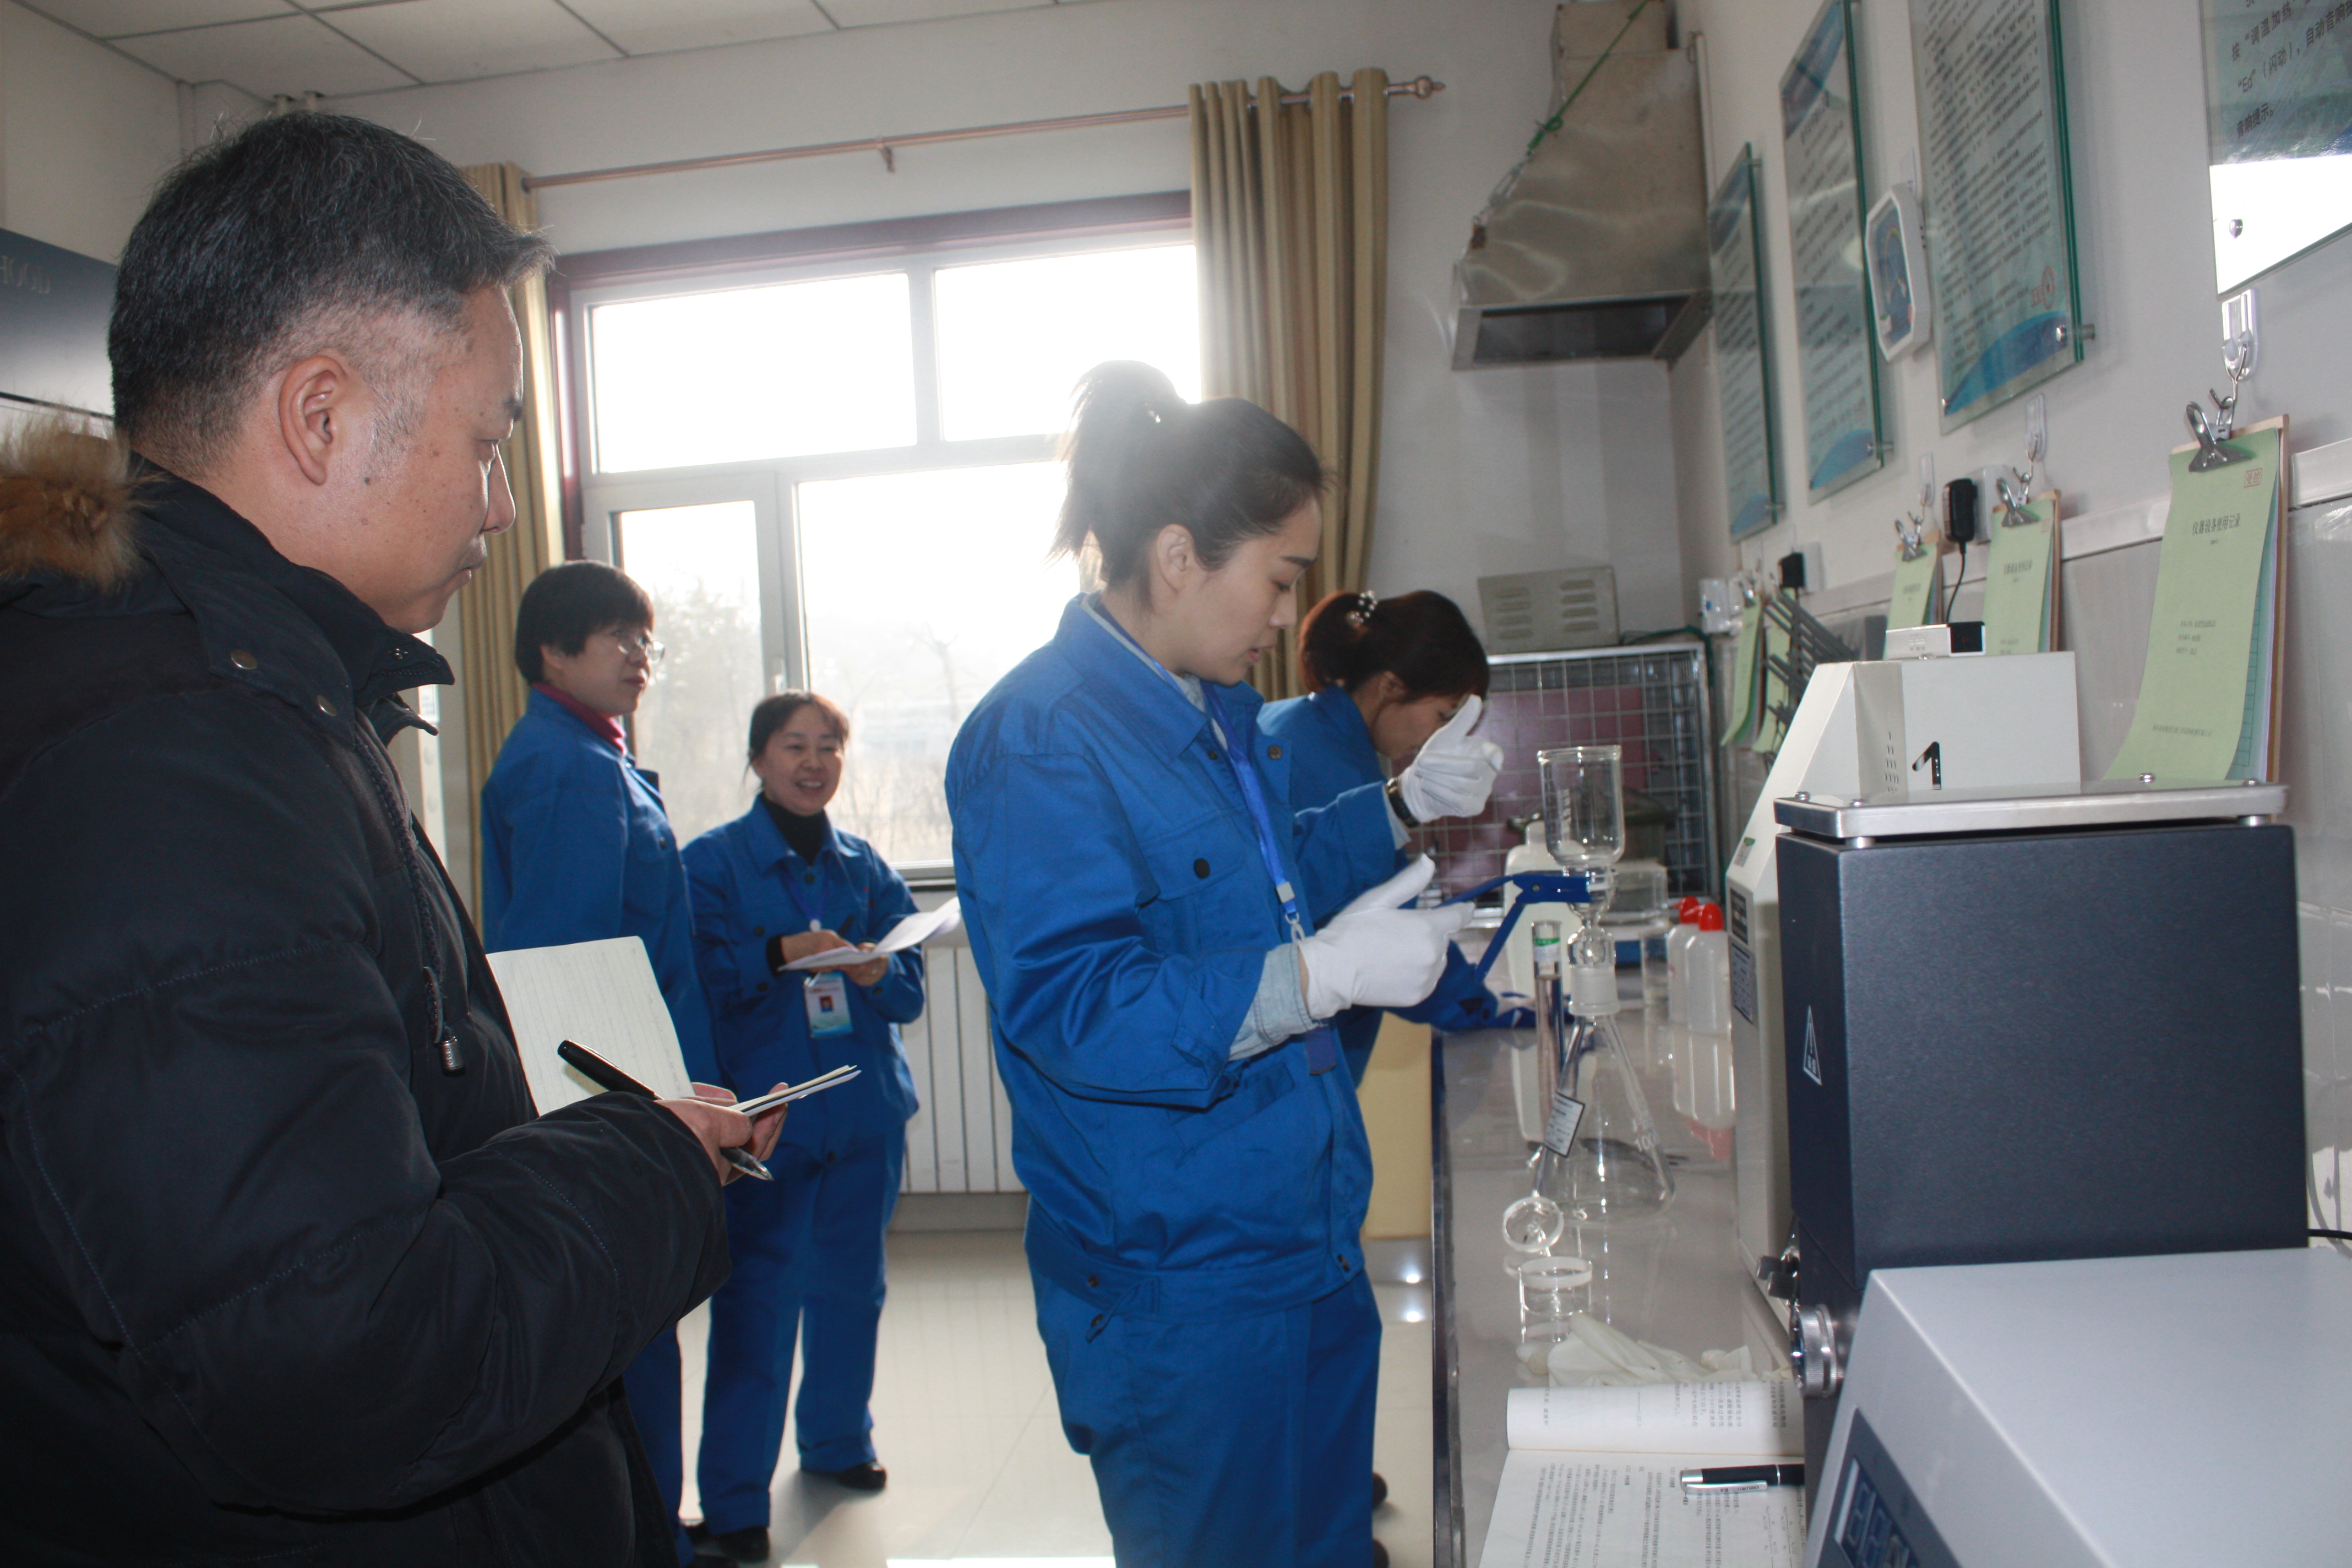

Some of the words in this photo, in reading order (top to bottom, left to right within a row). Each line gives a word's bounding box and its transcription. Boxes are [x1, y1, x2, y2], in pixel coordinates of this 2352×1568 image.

[2192, 513, 2241, 535] 仪器设备使用记录
